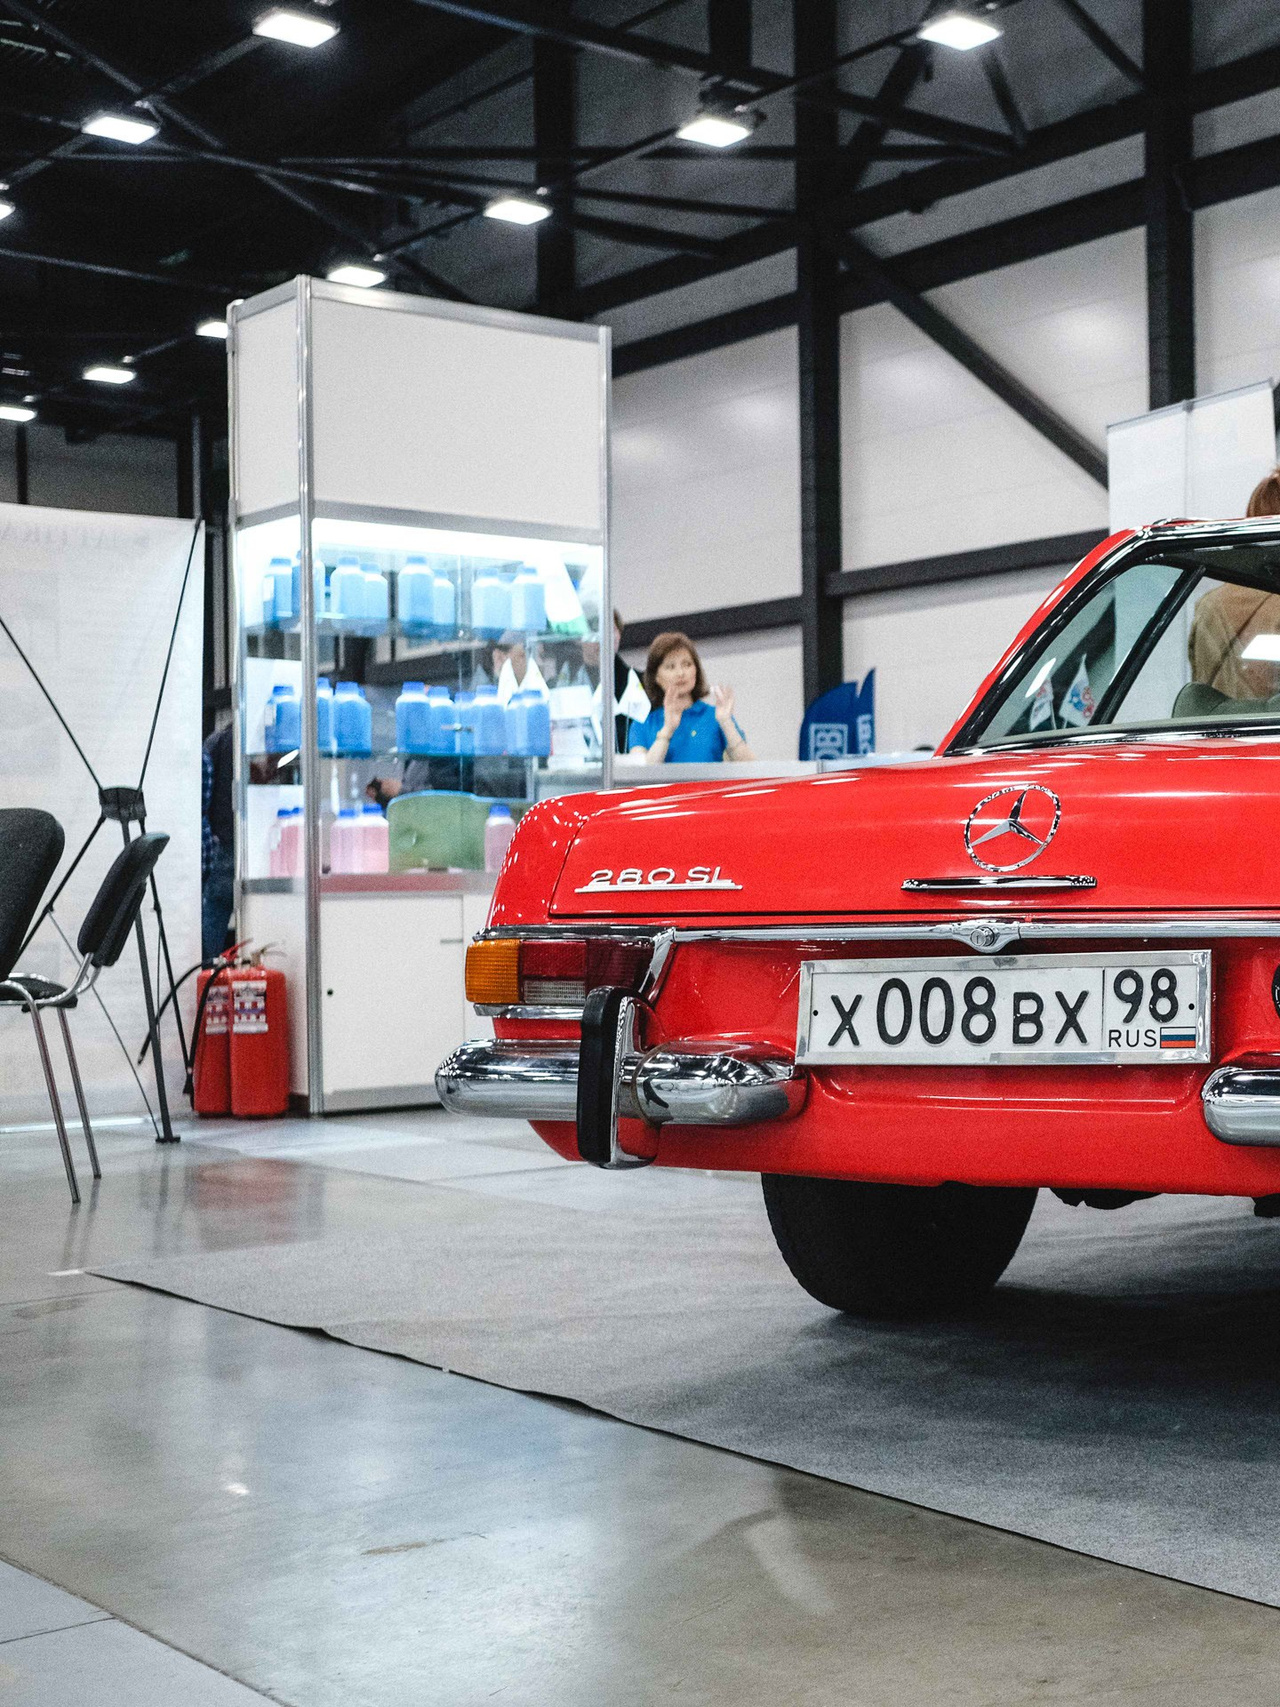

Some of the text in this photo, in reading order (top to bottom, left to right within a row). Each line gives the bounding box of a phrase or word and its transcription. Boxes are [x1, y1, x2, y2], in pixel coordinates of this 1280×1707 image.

[588, 867, 676, 887] 280
[1113, 967, 1179, 1024] 98
[1108, 1028, 1158, 1049] RUS
